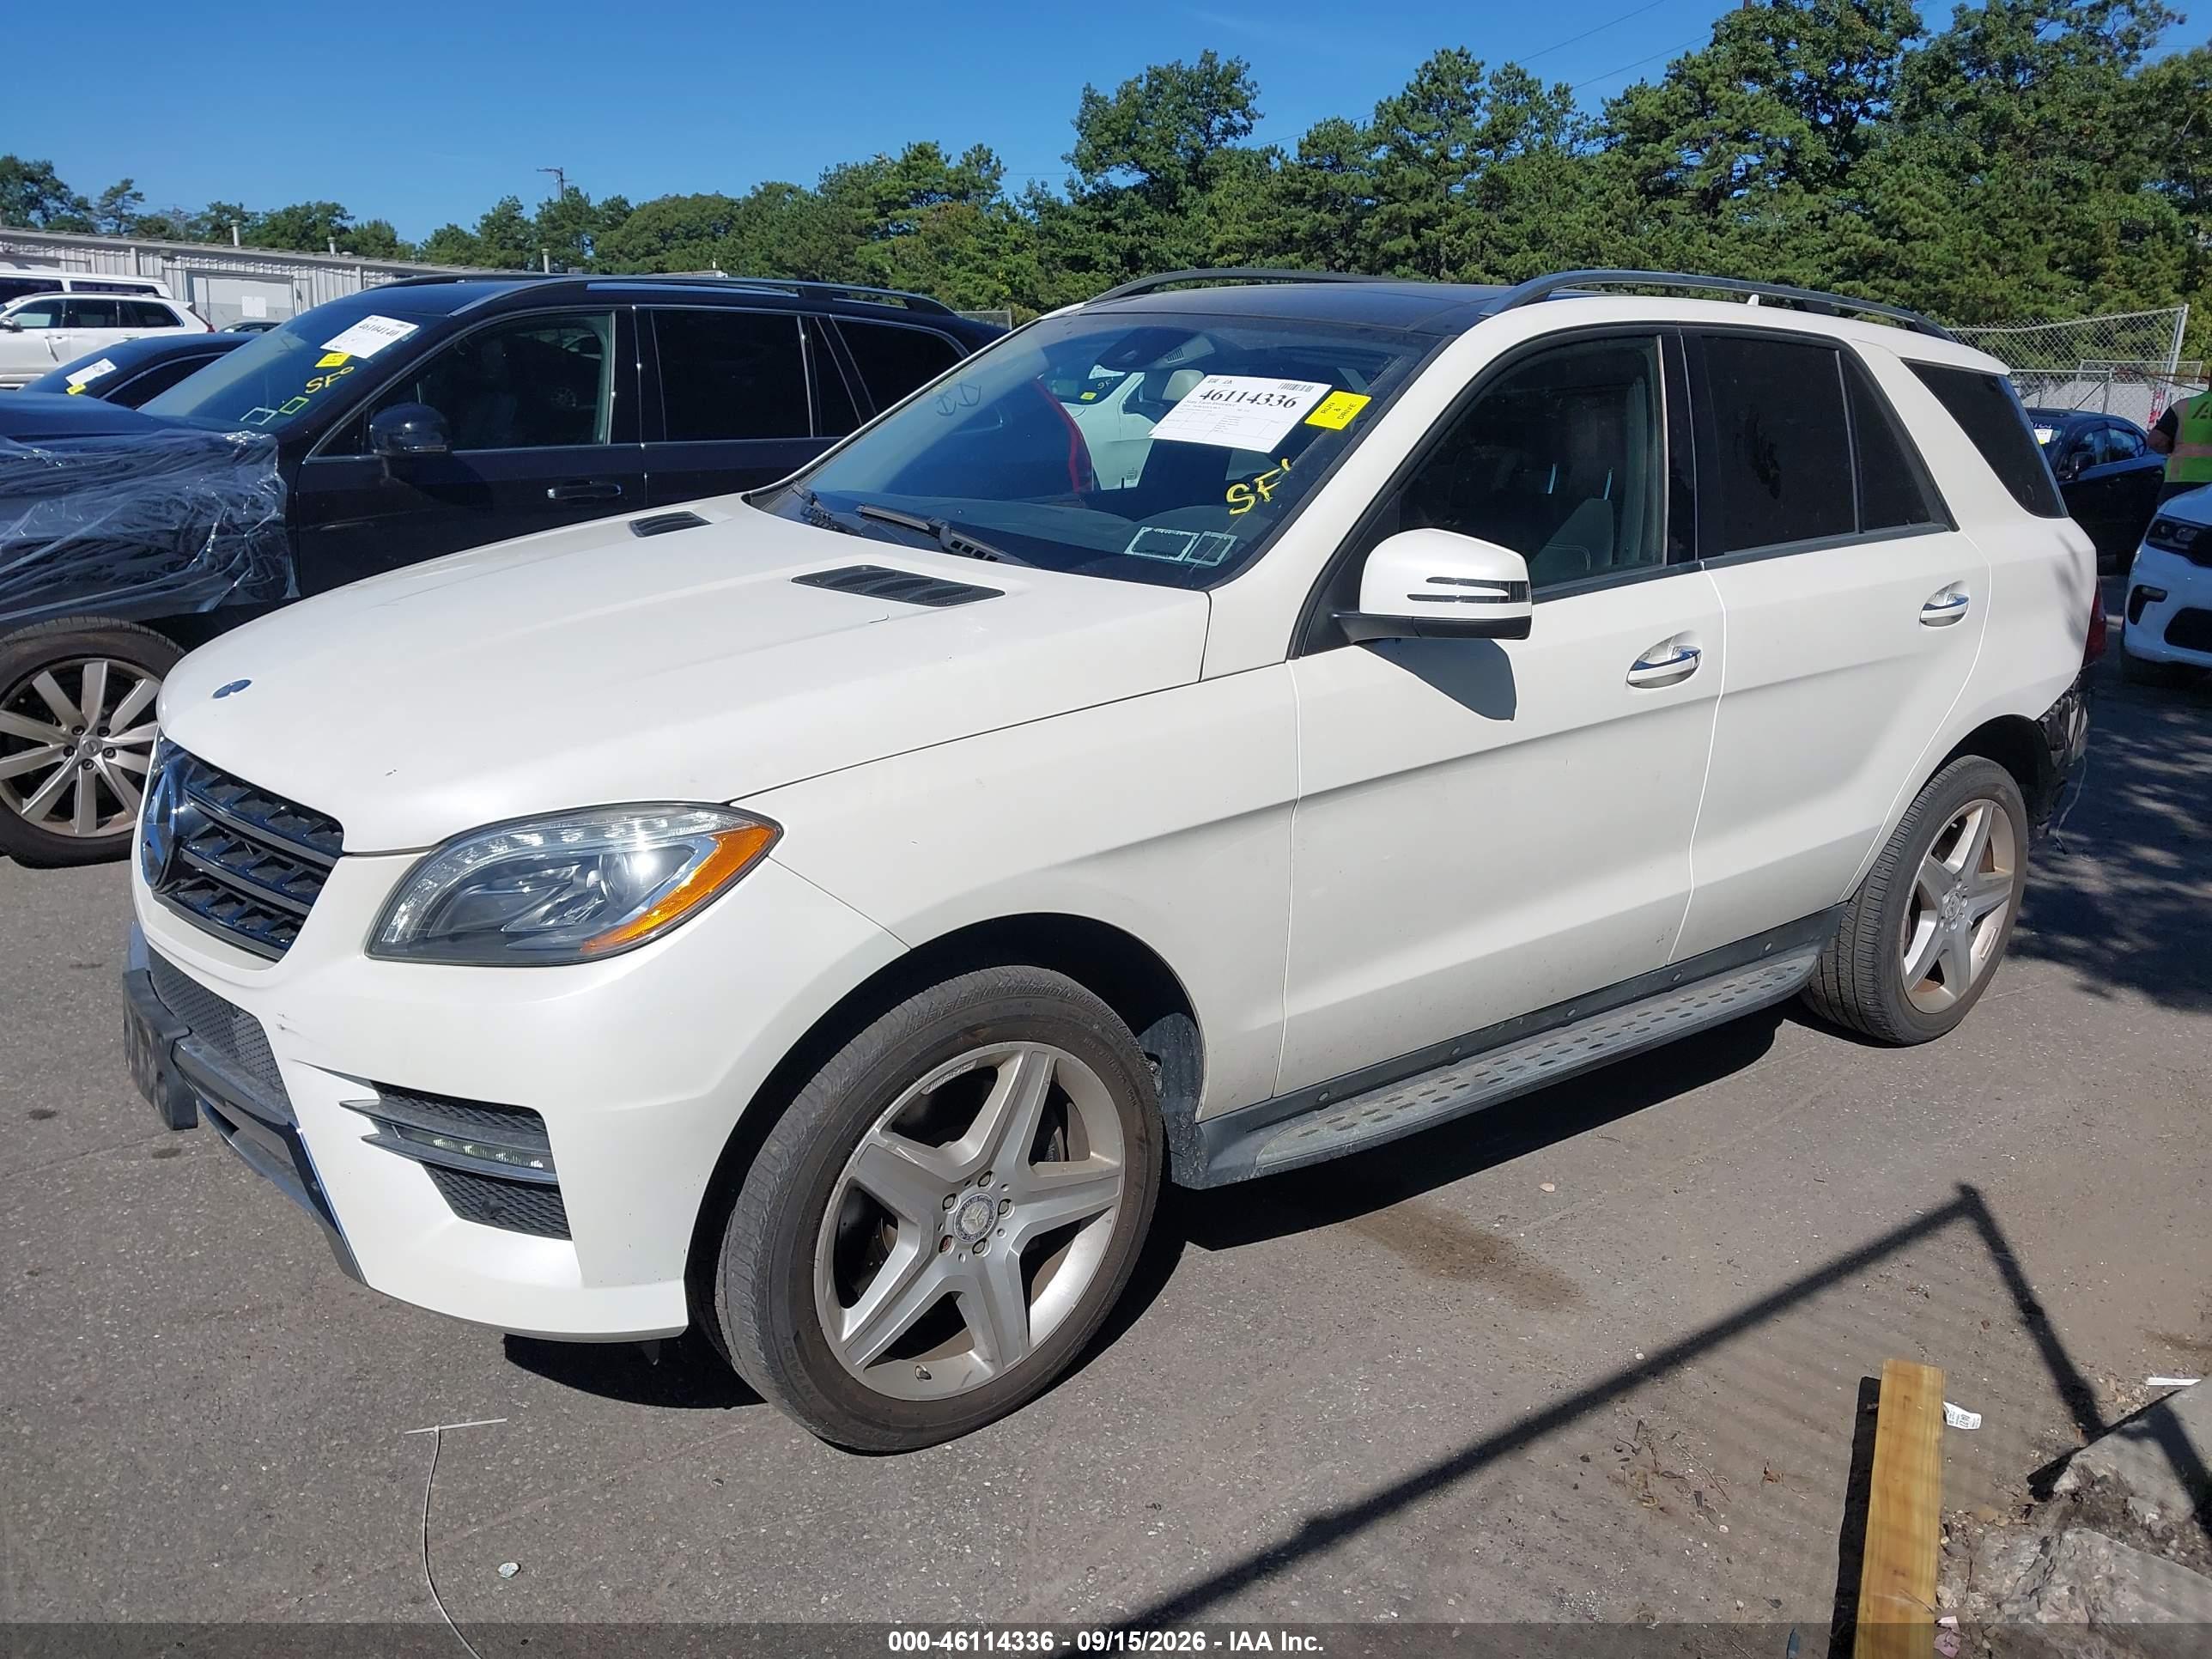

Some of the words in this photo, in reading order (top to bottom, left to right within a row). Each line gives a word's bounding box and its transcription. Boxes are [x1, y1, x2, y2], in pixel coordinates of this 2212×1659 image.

[1199, 389, 1304, 409] 46114336
[1320, 402, 1336, 415] RUN
[1337, 403, 1357, 420] DRIVE
